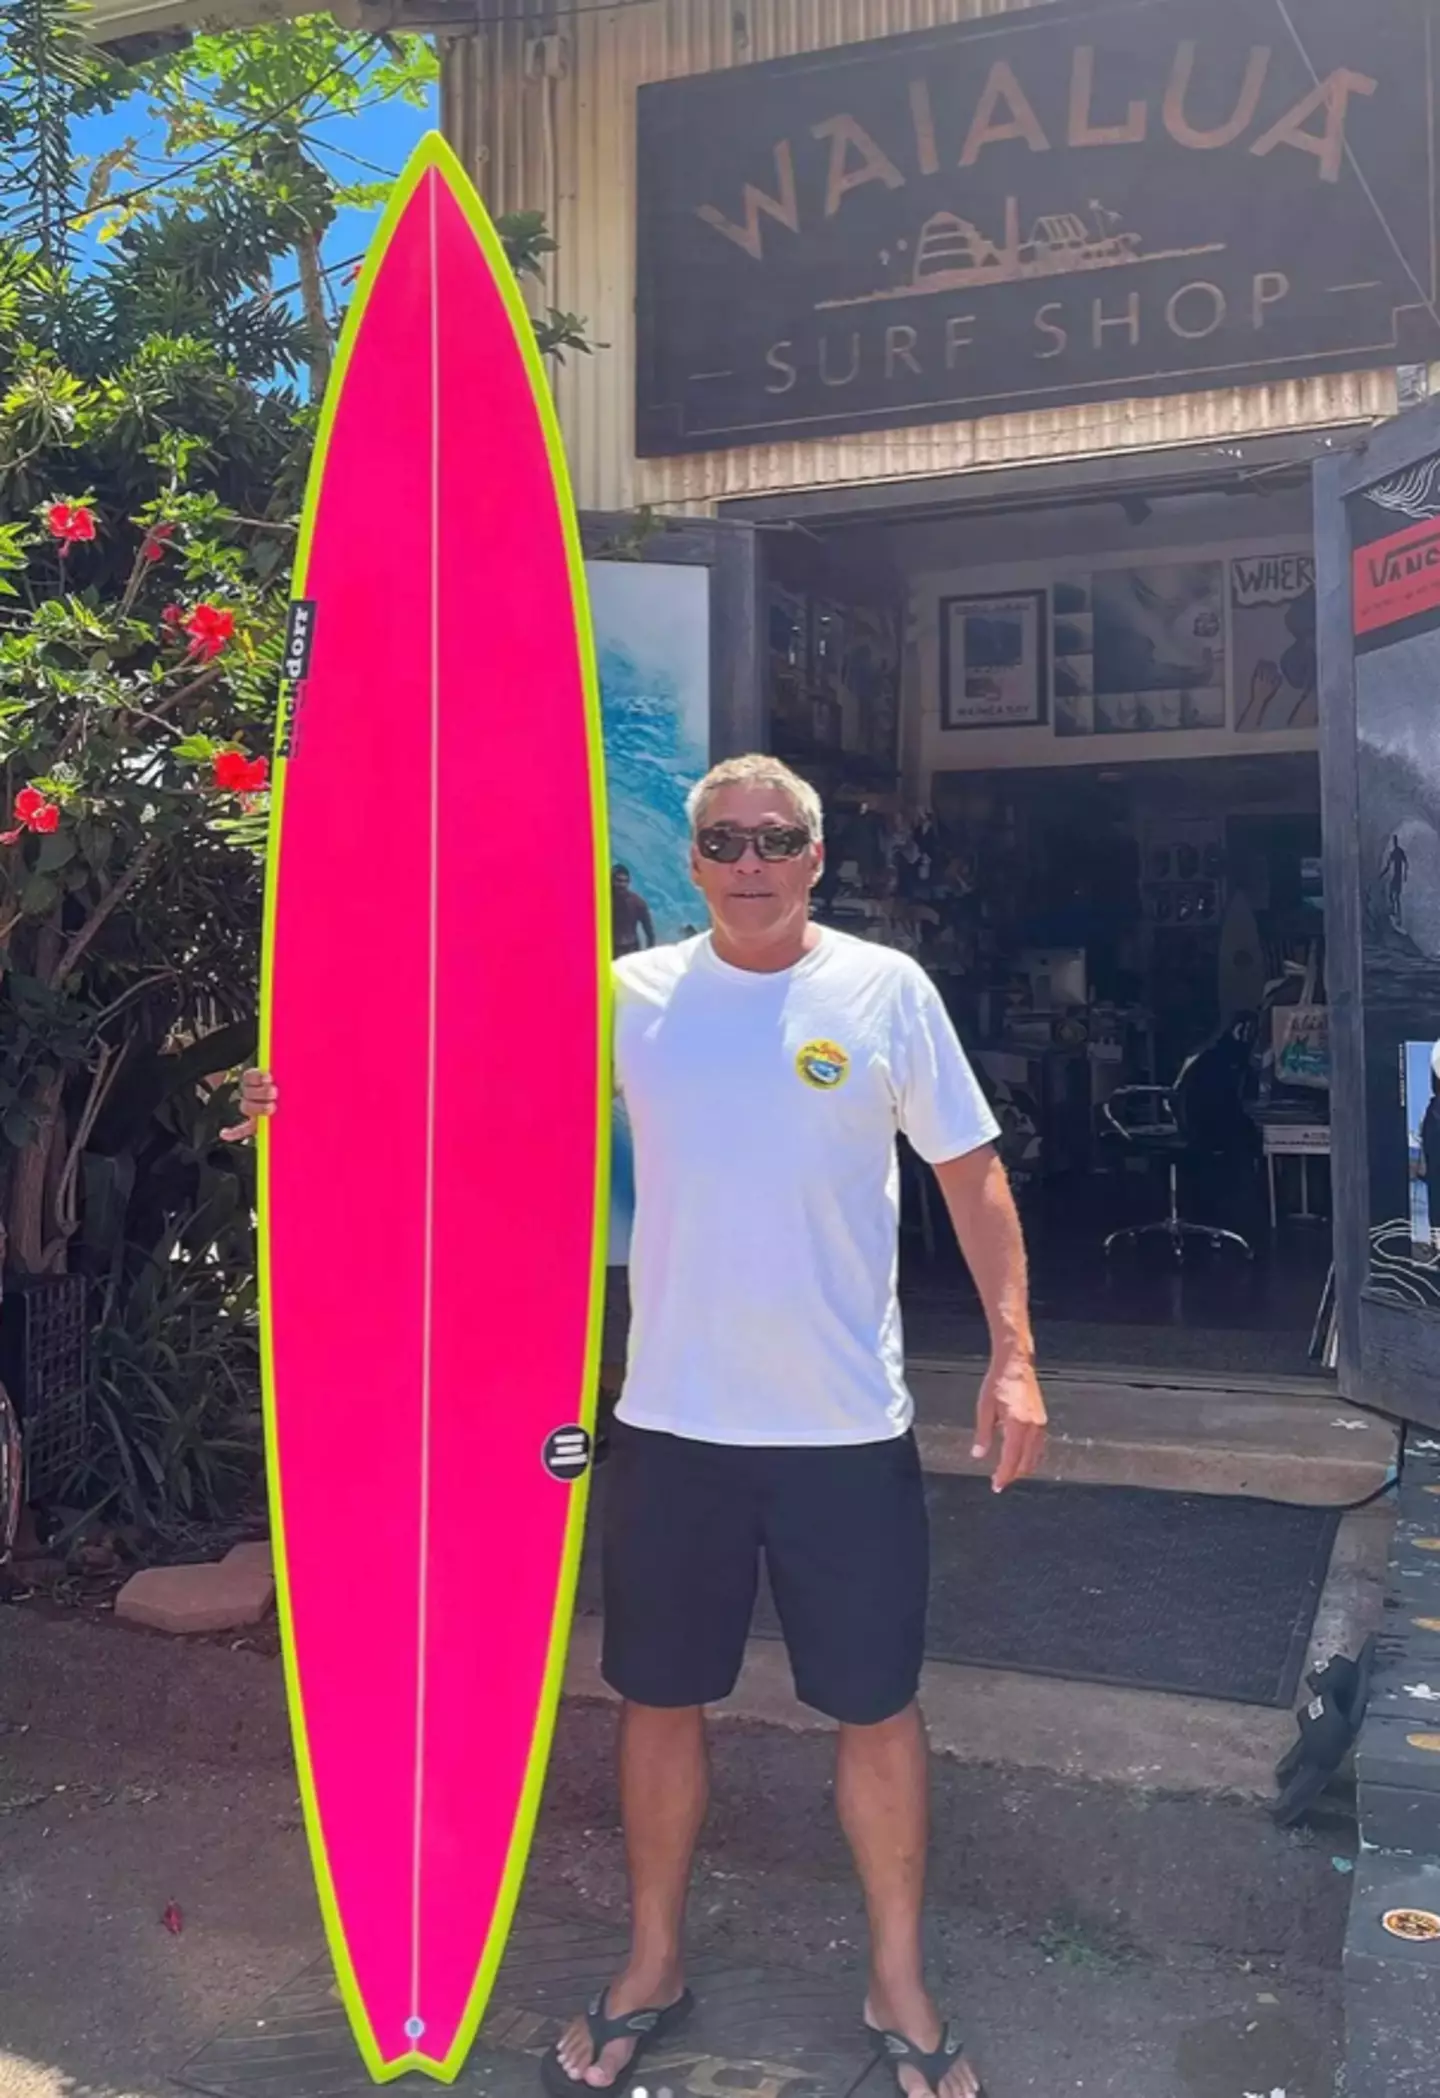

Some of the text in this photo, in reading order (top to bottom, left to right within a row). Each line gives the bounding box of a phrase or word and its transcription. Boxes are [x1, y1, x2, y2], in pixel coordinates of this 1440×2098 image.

[694, 40, 1378, 260] WAIALUA
[765, 271, 1290, 394] SURF SHOP
[1234, 557, 1315, 594] WHER
